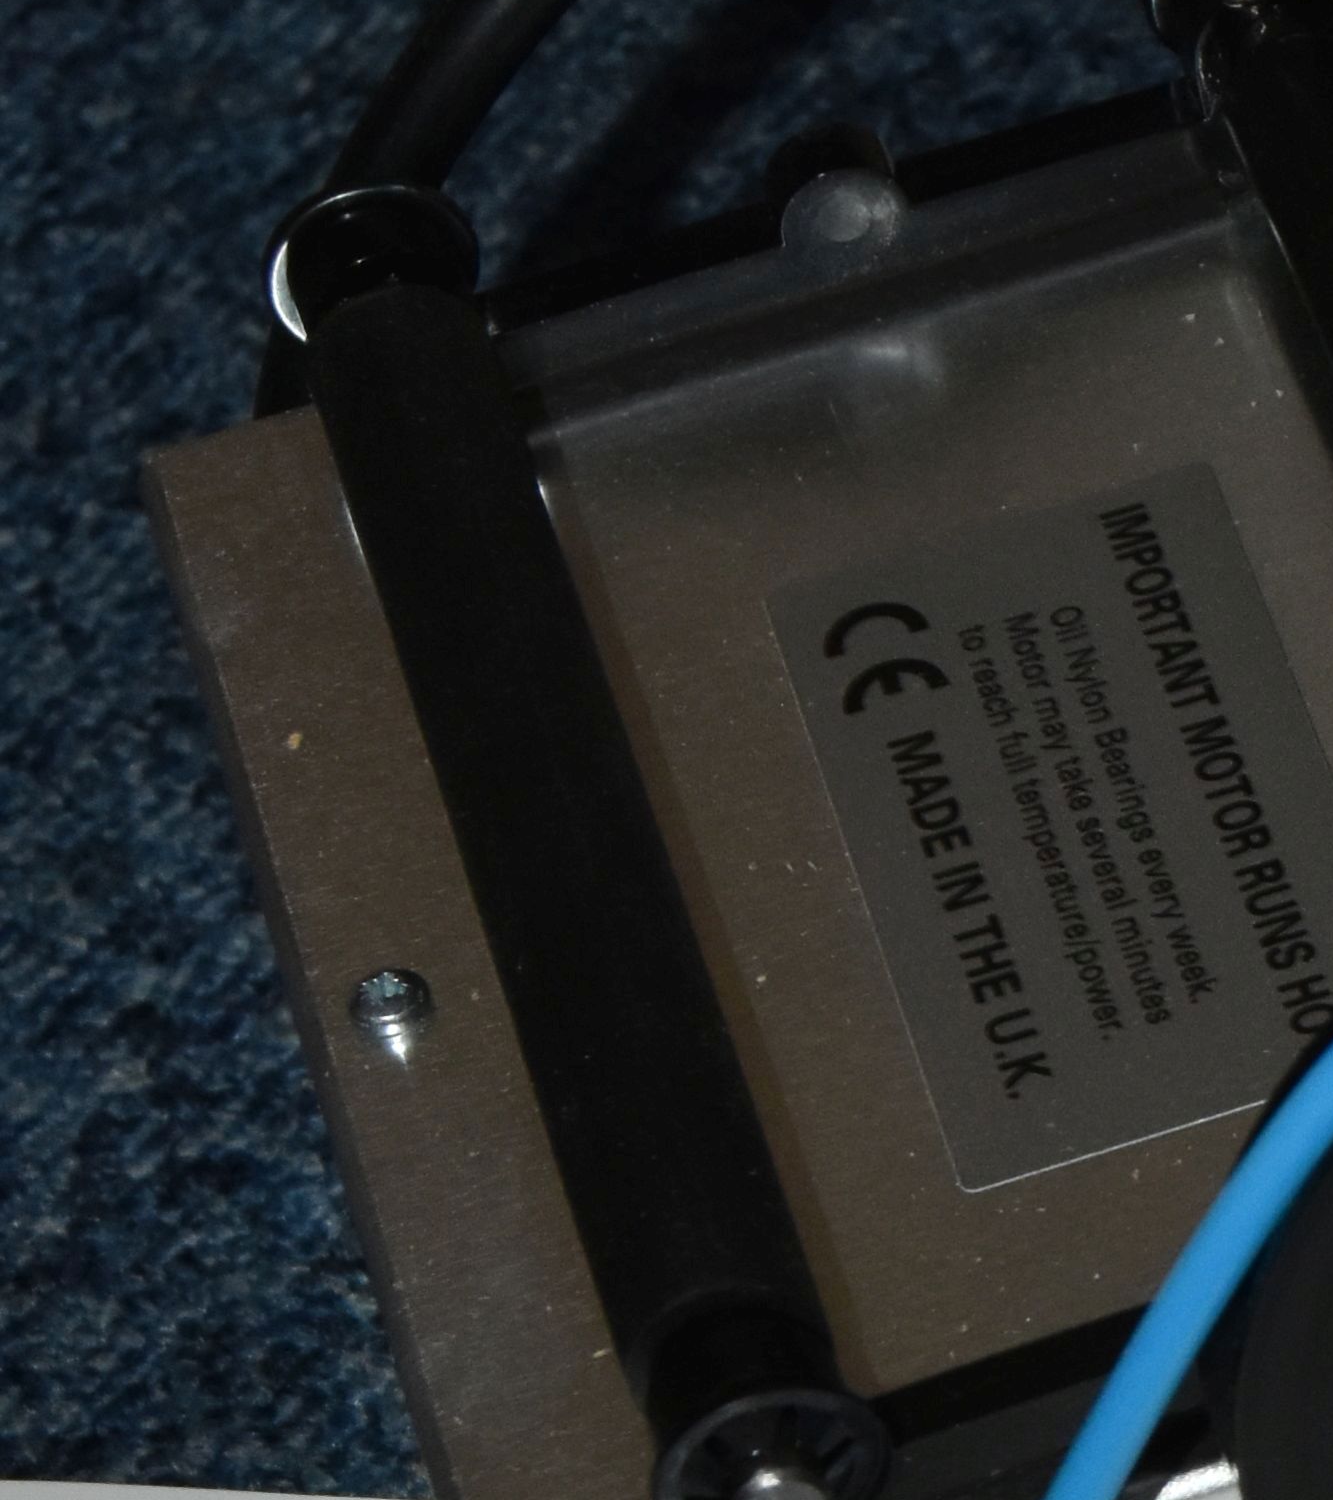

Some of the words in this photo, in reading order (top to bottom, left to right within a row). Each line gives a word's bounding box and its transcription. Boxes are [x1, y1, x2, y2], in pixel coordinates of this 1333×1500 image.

[956, 623, 988, 654] to
[1001, 610, 1053, 690] Motor
[1048, 604, 1090, 645] Oil
[969, 656, 1021, 730] reach
[1031, 695, 1075, 753] may
[1062, 644, 1114, 726] Nylon
[995, 729, 1039, 777] full
[1097, 501, 1222, 711] IMPORTANT
[1178, 713, 1275, 860] MOTOR
[1232, 856, 1318, 972] RUNS
[885, 728, 974, 860] MADE
[1053, 754, 1096, 813] take
[1092, 725, 1157, 845] Bearings
[931, 860, 993, 914] IN
[1074, 815, 1140, 912] several
[1135, 847, 1186, 921] every
[1010, 777, 1125, 1043] temperature/power.
[951, 912, 1024, 1006] THE
[1110, 914, 1174, 1027] minutes
[1164, 923, 1220, 1006] week.
[983, 1006, 1054, 1101] U.K.
